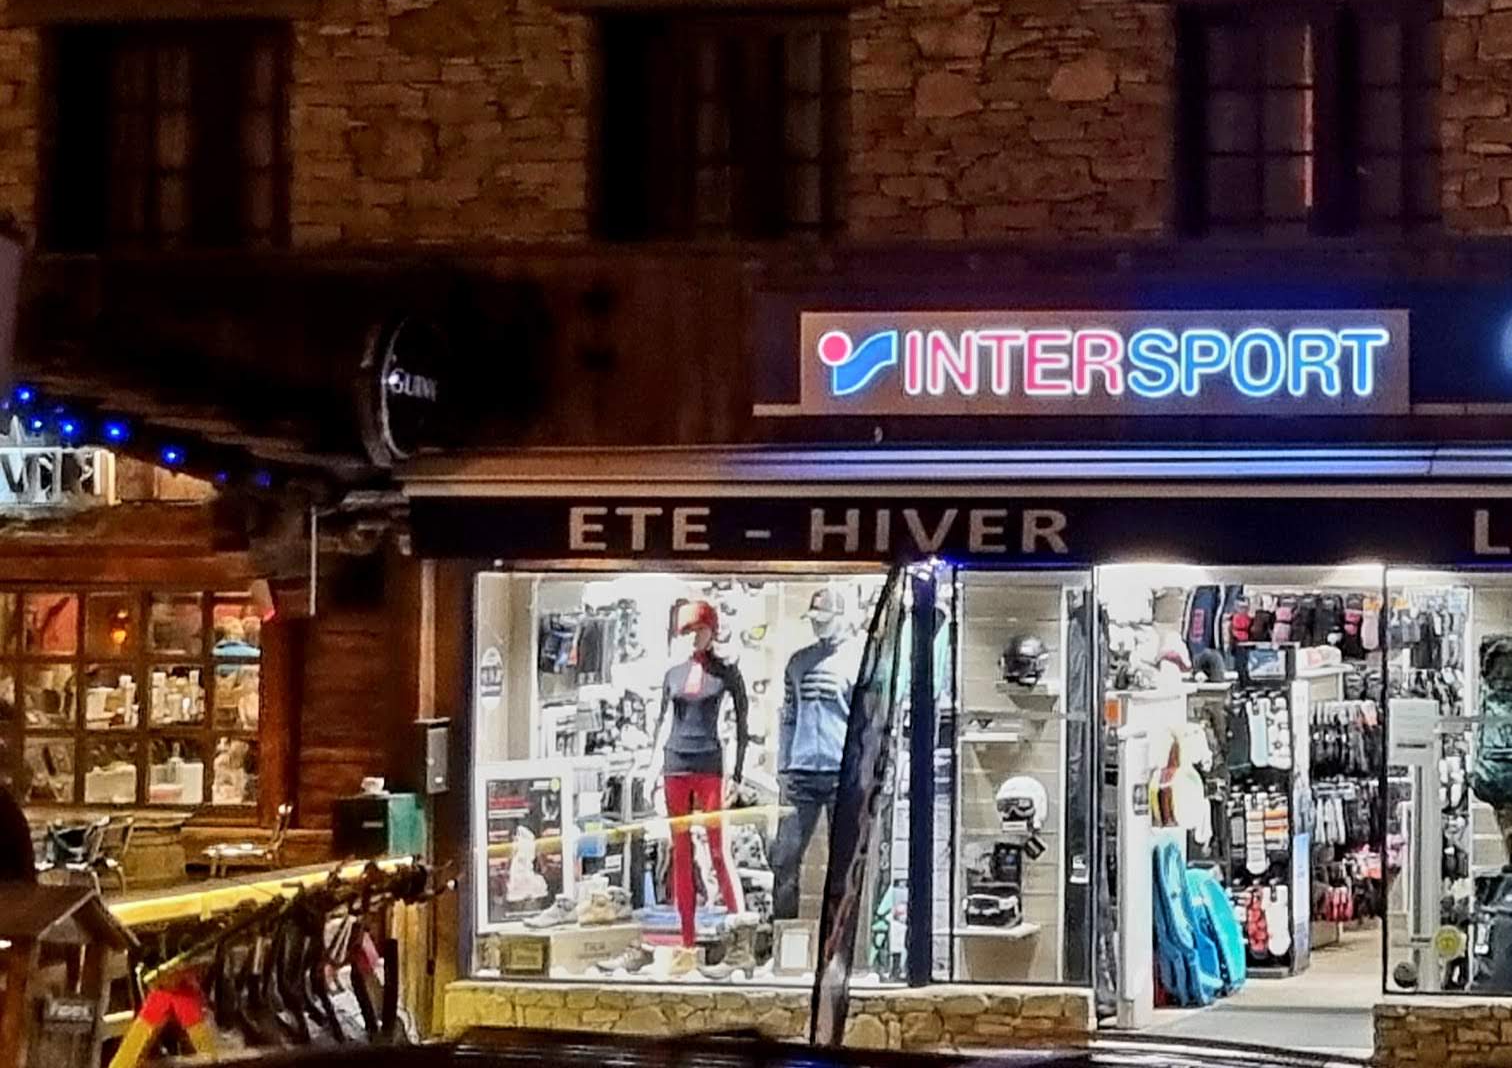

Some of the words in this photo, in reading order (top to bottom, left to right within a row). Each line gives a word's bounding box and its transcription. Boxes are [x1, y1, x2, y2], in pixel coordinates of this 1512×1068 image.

[902, 327, 1390, 398] INTERSPORT
[568, 506, 711, 552] ETE
[809, 508, 1069, 553] HIVER
